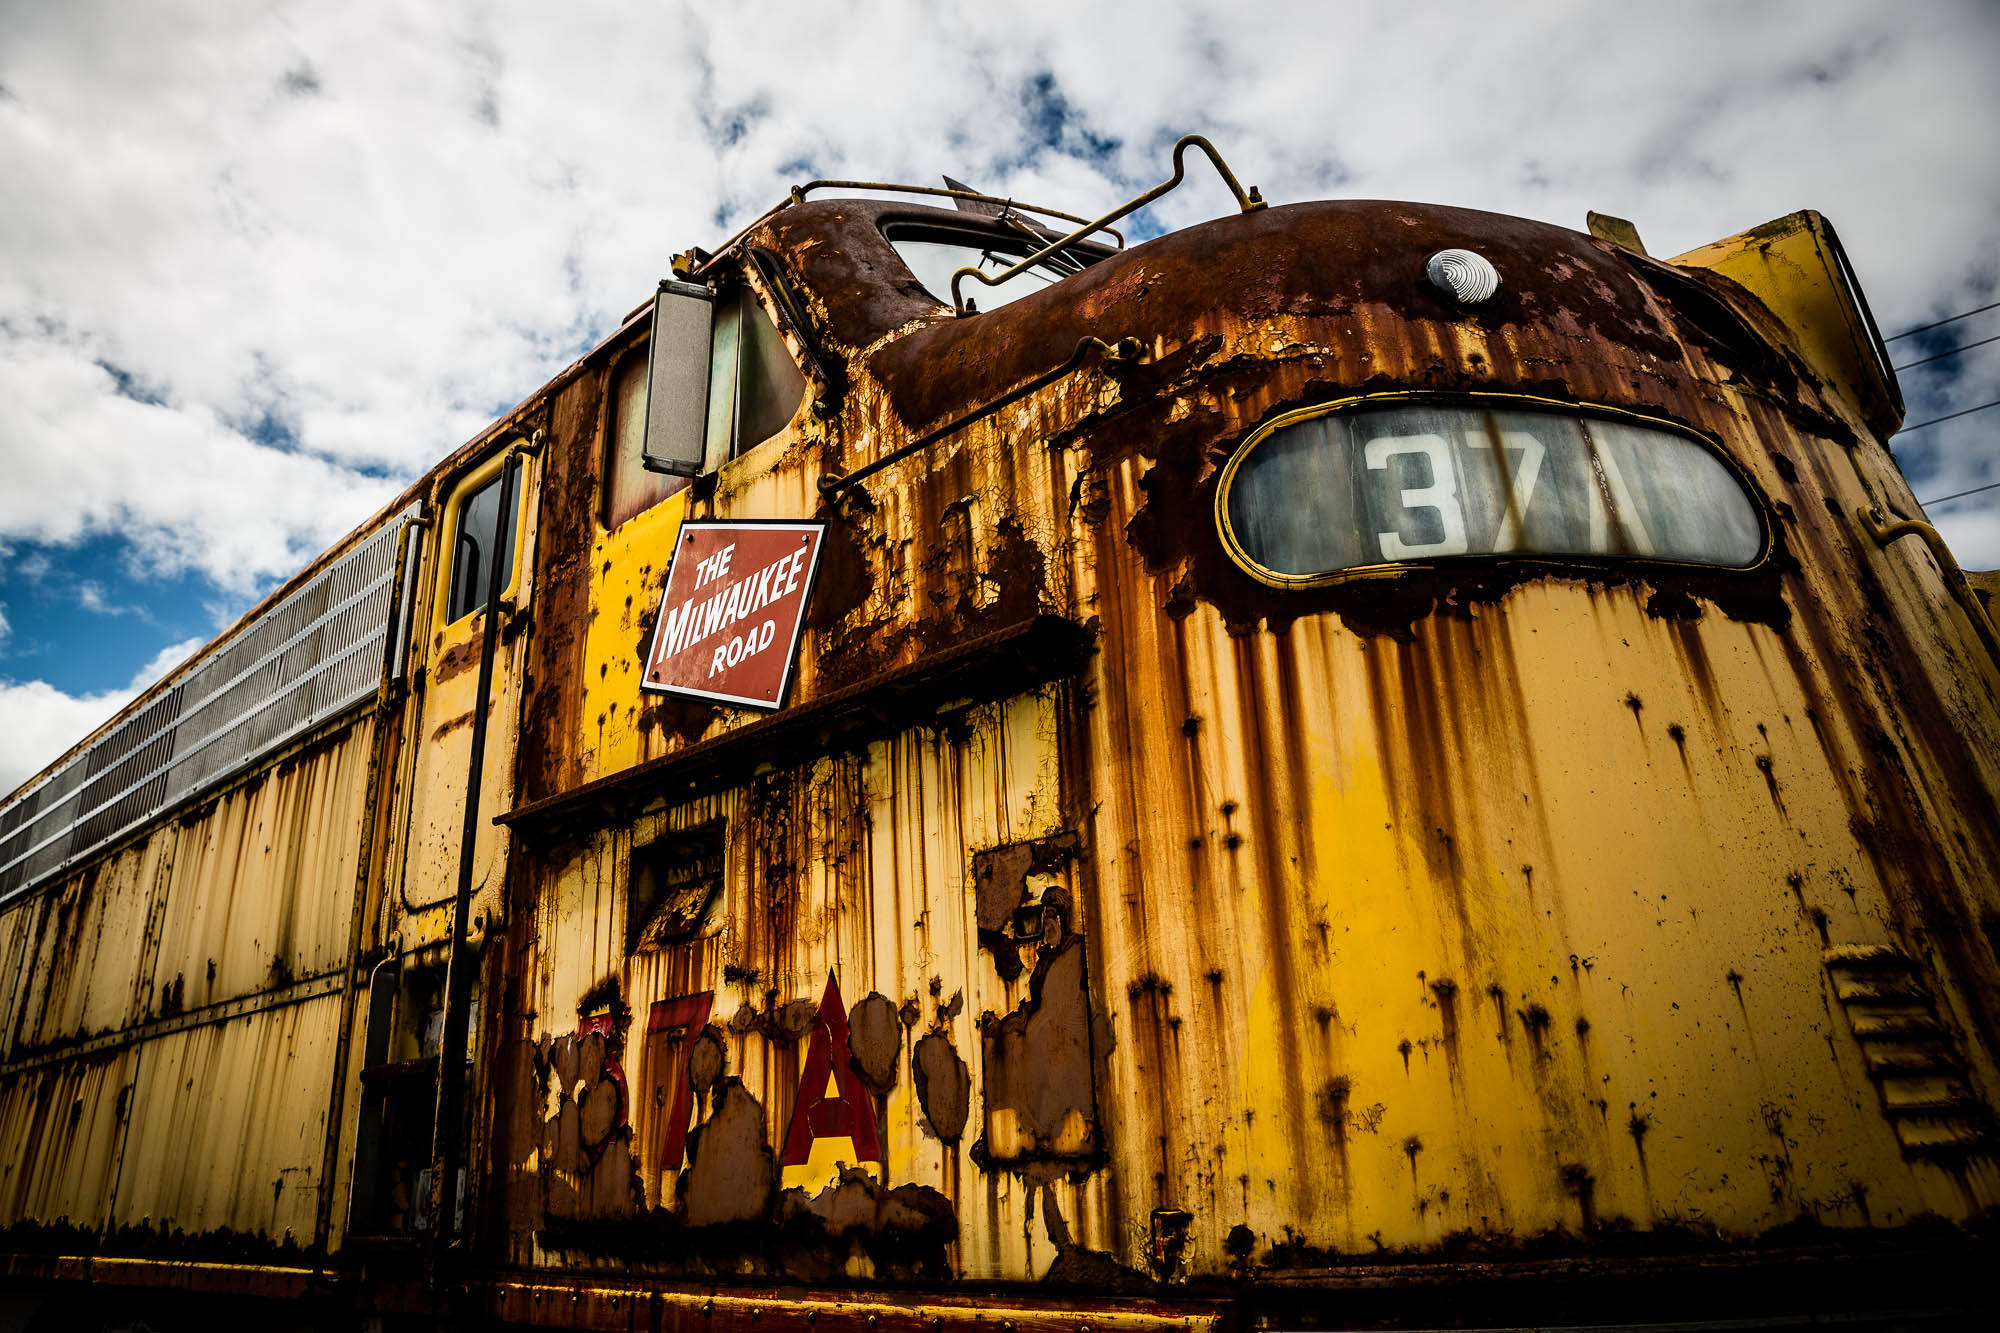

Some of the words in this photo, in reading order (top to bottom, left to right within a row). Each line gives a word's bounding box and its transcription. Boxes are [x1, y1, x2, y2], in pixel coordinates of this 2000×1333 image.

[694, 543, 735, 592] THE
[656, 545, 808, 665] MILWAUKEE
[708, 619, 776, 680] ROAD
